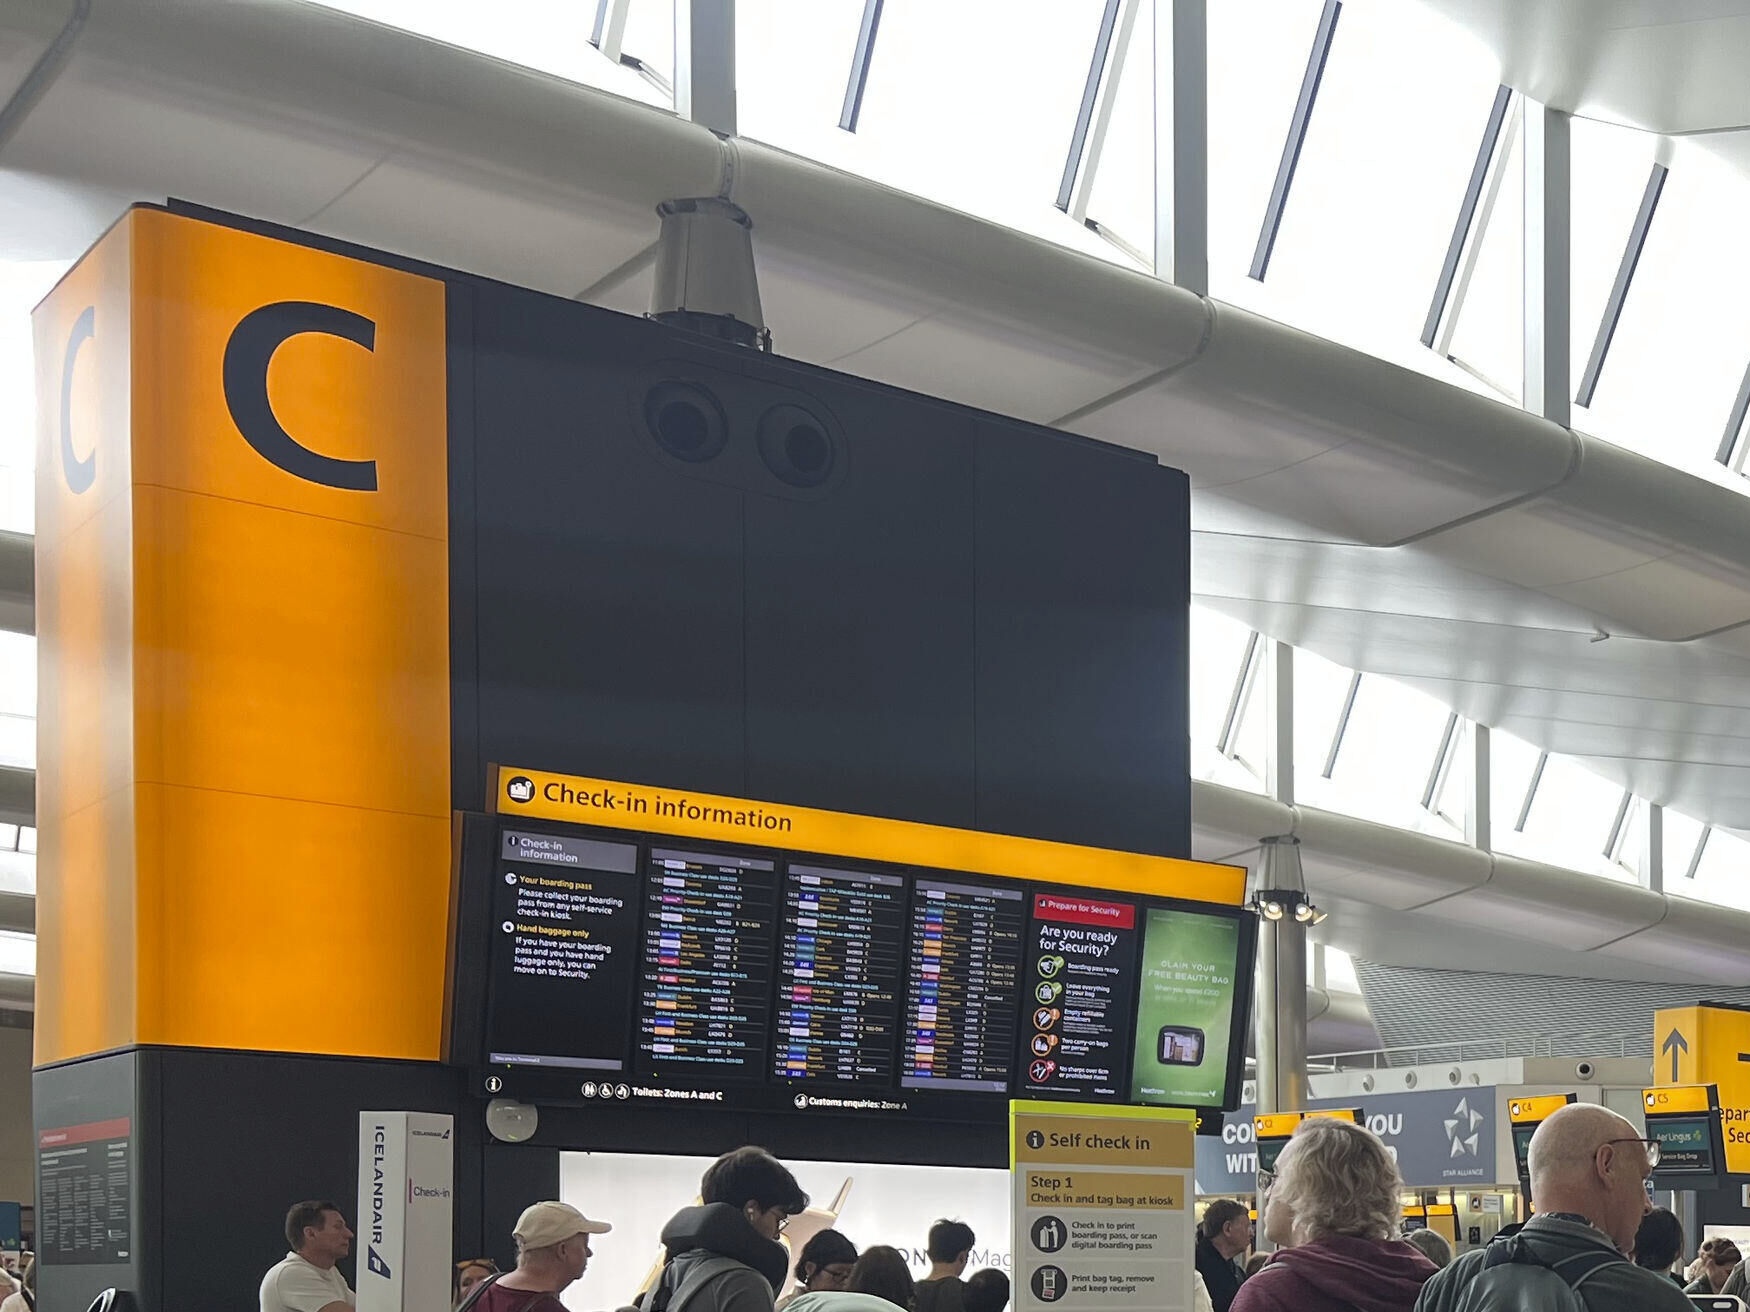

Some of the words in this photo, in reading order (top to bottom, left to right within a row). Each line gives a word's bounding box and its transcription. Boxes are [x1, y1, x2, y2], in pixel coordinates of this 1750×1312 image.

[61, 306, 96, 494] C
[223, 300, 378, 491] C
[544, 783, 647, 813] Check-in
[655, 796, 792, 833] information
[520, 838, 562, 851] Check-in
[520, 849, 578, 863] information
[520, 875, 538, 884] Your
[539, 877, 573, 889] boarding
[575, 882, 592, 890] pass
[1048, 900, 1077, 912] Prepare
[1078, 903, 1089, 912] for
[1090, 906, 1120, 918] Security
[517, 924, 537, 933] Hand
[538, 925, 571, 937] baggage
[572, 928, 590, 939] only
[1040, 925, 1060, 937] Are
[1062, 928, 1084, 941] you
[1086, 930, 1118, 945] ready
[1039, 938, 1057, 950] for
[1058, 940, 1110, 958] Security?
[1160, 960, 1188, 970] CLAIM
[1192, 963, 1215, 972] YOUR
[1148, 969, 1172, 979] FREE
[1175, 972, 1210, 982] BEAUTY
[1211, 975, 1229, 984] BAG
[632, 1086, 663, 1098] Toilets:
[664, 1088, 689, 1099] Zones
[690, 1089, 698, 1099] A
[699, 1090, 715, 1100] and
[716, 1091, 723, 1100] C
[809, 1097, 842, 1106] Customs
[843, 1100, 880, 1109] enquiries:
[881, 1101, 900, 1109] Zone
[901, 1102, 908, 1110] A
[1522, 1103, 1532, 1112] C4
[1050, 1133, 1082, 1147] Self
[1085, 1134, 1131, 1149] check
[1135, 1136, 1150, 1150] in
[1657, 1134, 1668, 1142] Aer
[1668, 1132, 1691, 1143] Lingus
[1442, 1169, 1457, 1177] STAR
[372, 1125, 385, 1244] ICELANDAIR
[1031, 1176, 1060, 1190] Step
[1065, 1177, 1073, 1188] 1
[413, 1186, 450, 1198] Check-in
[1031, 1193, 1060, 1203] Check
[1064, 1193, 1072, 1203] in
[1076, 1194, 1094, 1204] and
[1097, 1196, 1113, 1206] tag
[1116, 1196, 1134, 1206] bag
[1137, 1197, 1146, 1205] at
[1149, 1196, 1174, 1206] kiosk
[1072, 1231, 1107, 1240] boarding
[1072, 1241, 1097, 1250] digital
[1098, 1242, 1134, 1250] boarding
[1093, 1275, 1107, 1284] bag
[1109, 1276, 1124, 1284] tag,
[1089, 1285, 1108, 1293] keep
[1110, 1285, 1136, 1293] receipt
